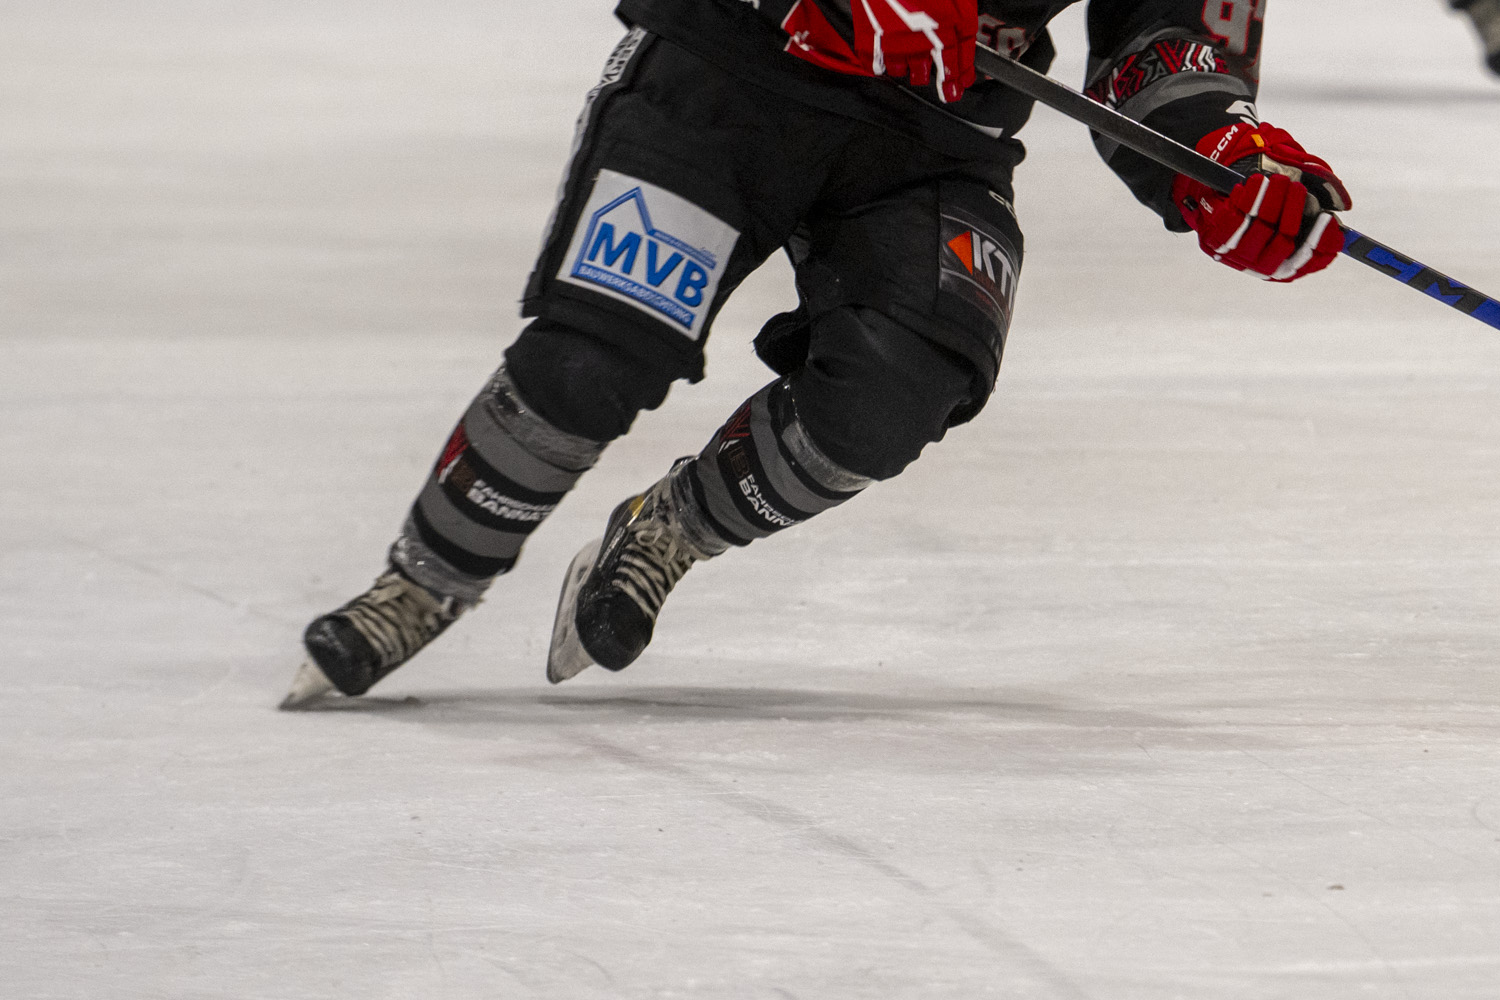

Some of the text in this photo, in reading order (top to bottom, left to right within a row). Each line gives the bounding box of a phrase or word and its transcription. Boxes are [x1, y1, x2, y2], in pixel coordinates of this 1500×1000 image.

[1209, 125, 1238, 161] CCM
[587, 222, 708, 307] MVB
[1346, 226, 1487, 316] CM
